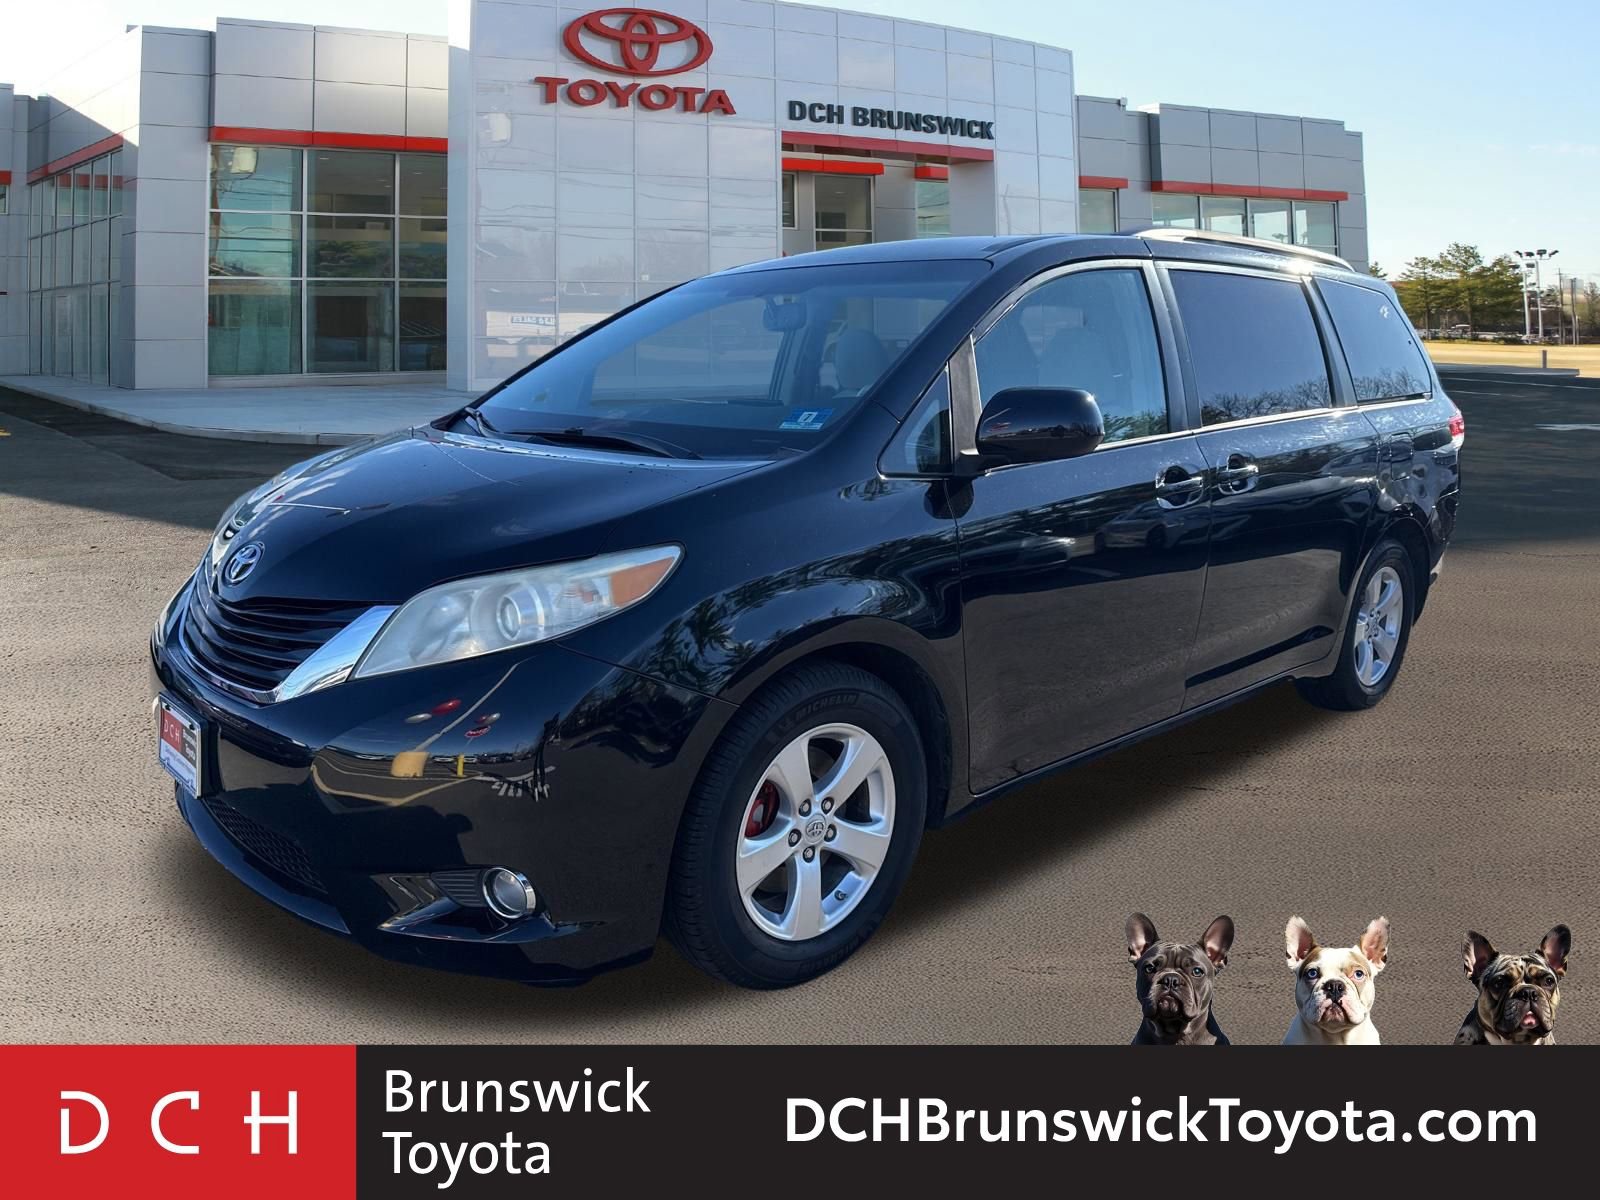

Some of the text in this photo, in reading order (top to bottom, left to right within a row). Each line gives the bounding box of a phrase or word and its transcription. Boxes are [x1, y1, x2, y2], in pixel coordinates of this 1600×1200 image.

[534, 76, 737, 115] TOYOTA
[788, 100, 994, 140] DCH BRUNSWICK
[795, 694, 857, 720] MICHELIN
[163, 719, 180, 744] DCH
